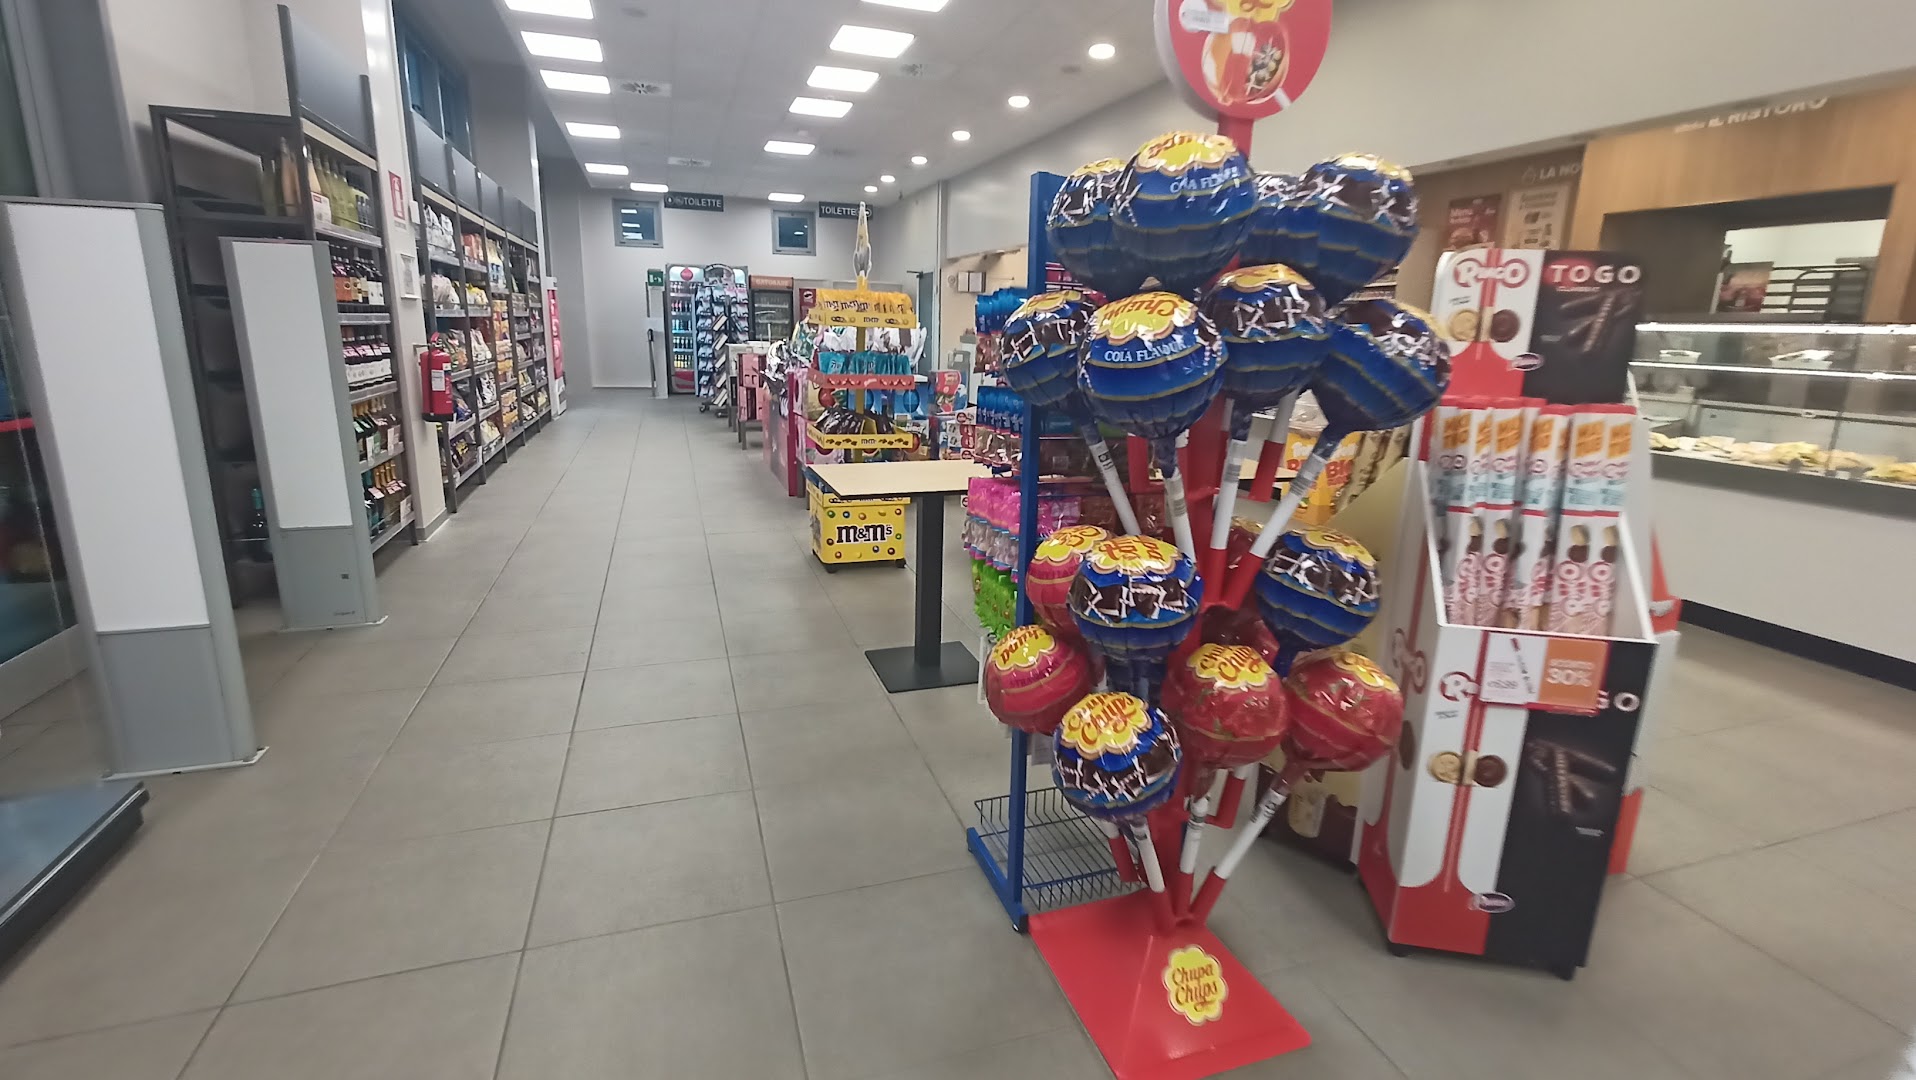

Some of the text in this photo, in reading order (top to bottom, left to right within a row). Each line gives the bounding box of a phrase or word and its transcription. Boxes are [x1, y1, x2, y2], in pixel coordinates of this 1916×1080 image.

[683, 196, 722, 208] TOILETTE
[820, 205, 857, 216] TOILETTE
[1550, 264, 1642, 285] TOGO
[1104, 350, 1133, 363] COLA
[1171, 963, 1214, 986] Chupa
[1175, 981, 1218, 1013] Chups
